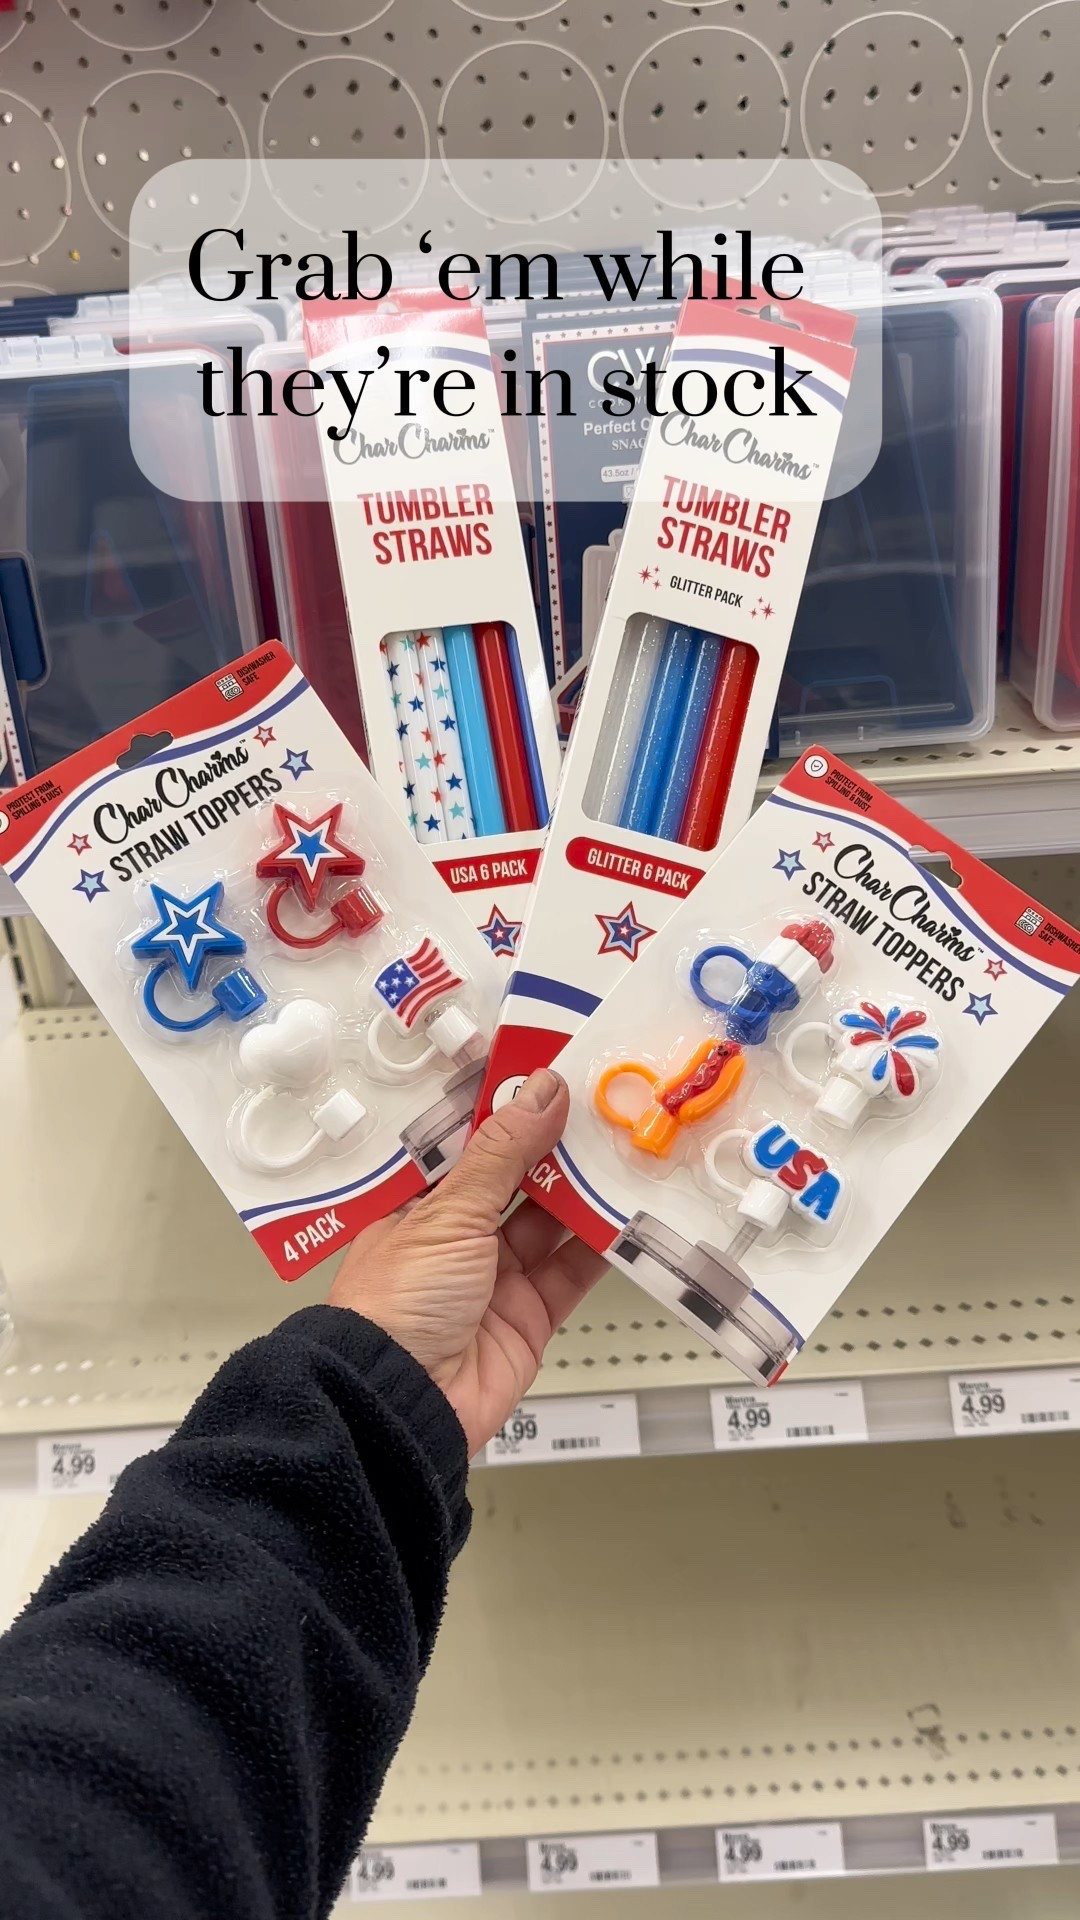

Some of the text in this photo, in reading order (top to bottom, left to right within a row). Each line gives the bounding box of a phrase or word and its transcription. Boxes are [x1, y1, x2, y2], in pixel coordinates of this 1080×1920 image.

[583, 420, 637, 436] Perfect
[602, 468, 630, 478] 43.5oz
[357, 483, 494, 526] TUMBLER
[662, 474, 791, 543] TUMBLER
[373, 522, 493, 565] STRAWS
[657, 516, 775, 579] STRAWS
[669, 575, 743, 608] GLITTER PACK
[236, 651, 277, 678] DISHWASHER
[241, 671, 260, 686] SAFE
[6, 779, 55, 812] PROTECT FROM
[11, 785, 64, 820] SPILLING & DUST
[824, 776, 871, 812] SPILLING & DUST
[830, 769, 873, 803] PROTECT FROM
[109, 766, 283, 882] STRAW TOPPERS
[450, 858, 528, 885] USA 6 PACK
[587, 847, 692, 891] GLITTER 6 PACK
[802, 871, 965, 1002] STRAW TOPPERS
[1037, 930, 1056, 946] SAFE
[754, 1124, 840, 1220] USA
[283, 1208, 346, 1263] 4 PACK
[727, 1408, 771, 1430] 4.99
[961, 1394, 1005, 1414] 4.99
[52, 1455, 96, 1476] 4.99
